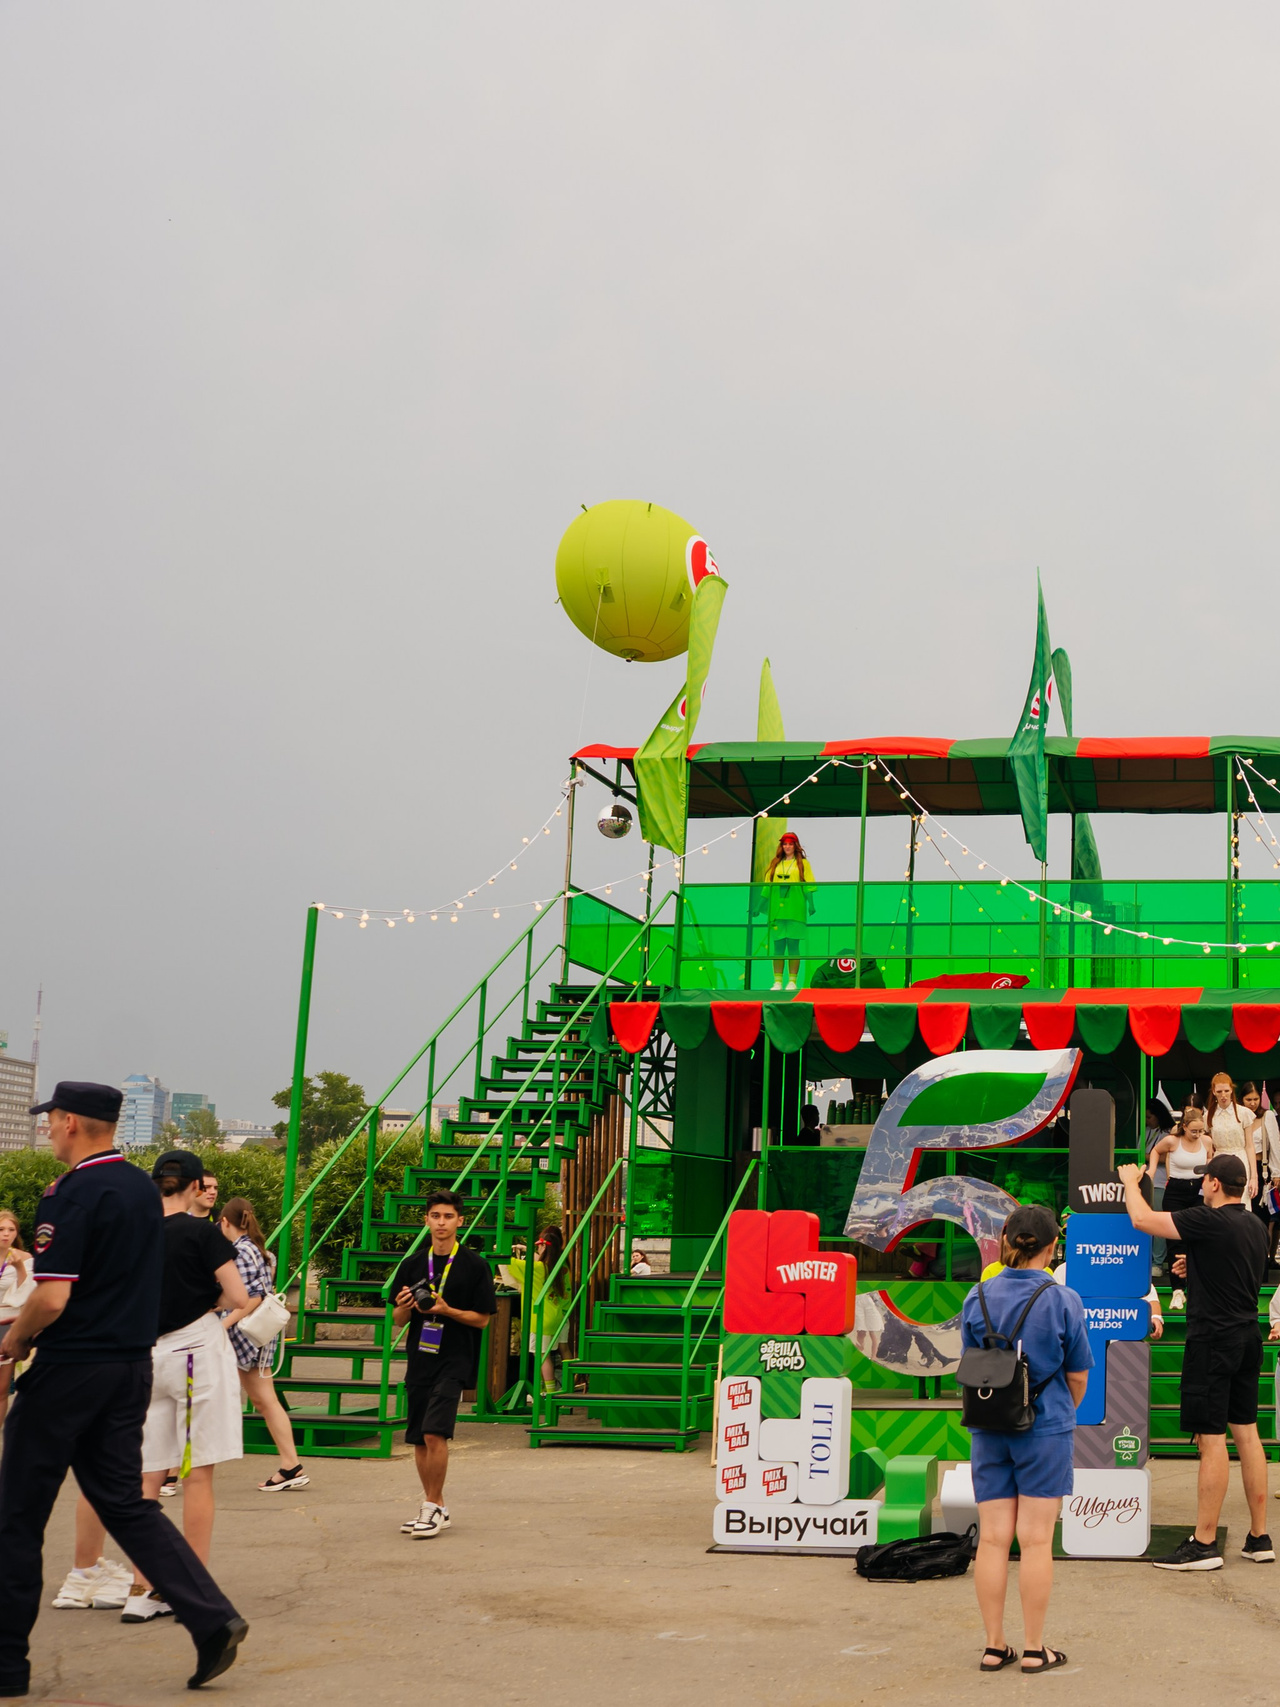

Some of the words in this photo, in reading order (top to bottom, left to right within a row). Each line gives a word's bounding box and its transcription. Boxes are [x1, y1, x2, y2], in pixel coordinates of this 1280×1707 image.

[1078, 1182, 1126, 1204] TWIST
[1076, 1244, 1140, 1257] MINÉRALE
[1090, 1256, 1124, 1265] SOCIÉTÉ
[776, 1260, 838, 1284] TWISTER
[1083, 1308, 1139, 1321] MINÉRAL
[1089, 1320, 1123, 1330] SOCIÉTÉ
[760, 1339, 802, 1357] Village
[760, 1353, 805, 1371] Global
[729, 1382, 747, 1396] MIX
[733, 1393, 750, 1406] BAR
[726, 1424, 744, 1438] MIX
[730, 1435, 747, 1448] BAR
[808, 1402, 834, 1480] TOLLI
[723, 1466, 741, 1480] MIX
[764, 1468, 782, 1482] MIX
[727, 1477, 744, 1490] BAR
[768, 1479, 785, 1492] BAR
[725, 1509, 869, 1542] Выручай
